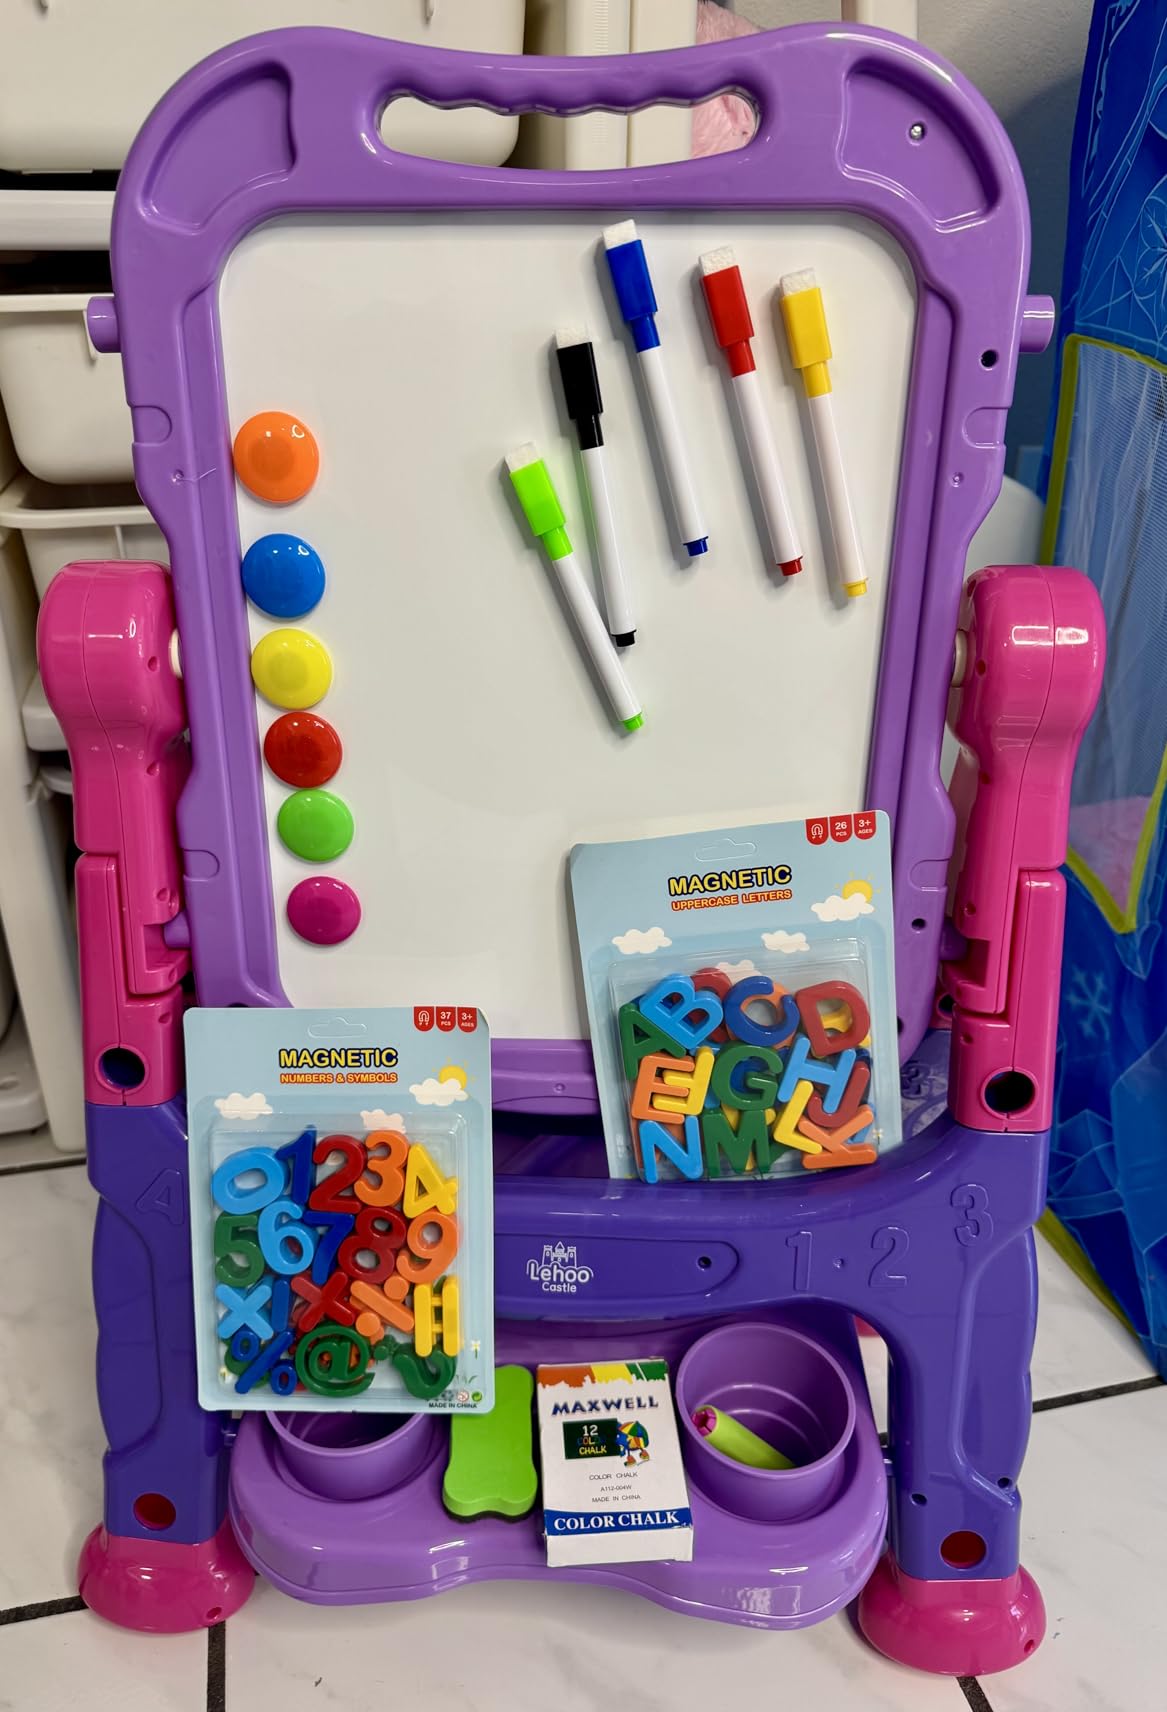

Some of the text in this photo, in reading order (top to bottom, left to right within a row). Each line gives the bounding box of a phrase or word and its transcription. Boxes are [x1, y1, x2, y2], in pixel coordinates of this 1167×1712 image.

[834, 821, 848, 830] 26
[858, 819, 872, 829] 3+
[668, 864, 793, 896] MAGNETIC
[671, 888, 793, 912] UPPERCASE LETTERS
[440, 1011, 452, 1020] 37
[461, 1012, 473, 1021] 3+
[279, 1048, 399, 1068] MAGNETIC
[280, 1073, 399, 1084] NUMBERS & SYMBOLS
[868, 1226, 910, 1288] 2
[950, 1183, 994, 1248] 3
[530, 1262, 590, 1283] Lehoo
[541, 1281, 577, 1293] Castle
[551, 1396, 659, 1416] MAXWELL
[582, 1424, 599, 1437] 12
[579, 1445, 607, 1455] CHALK
[616, 1471, 639, 1479] CHALK
[553, 1511, 680, 1531] COLOR CHALK
